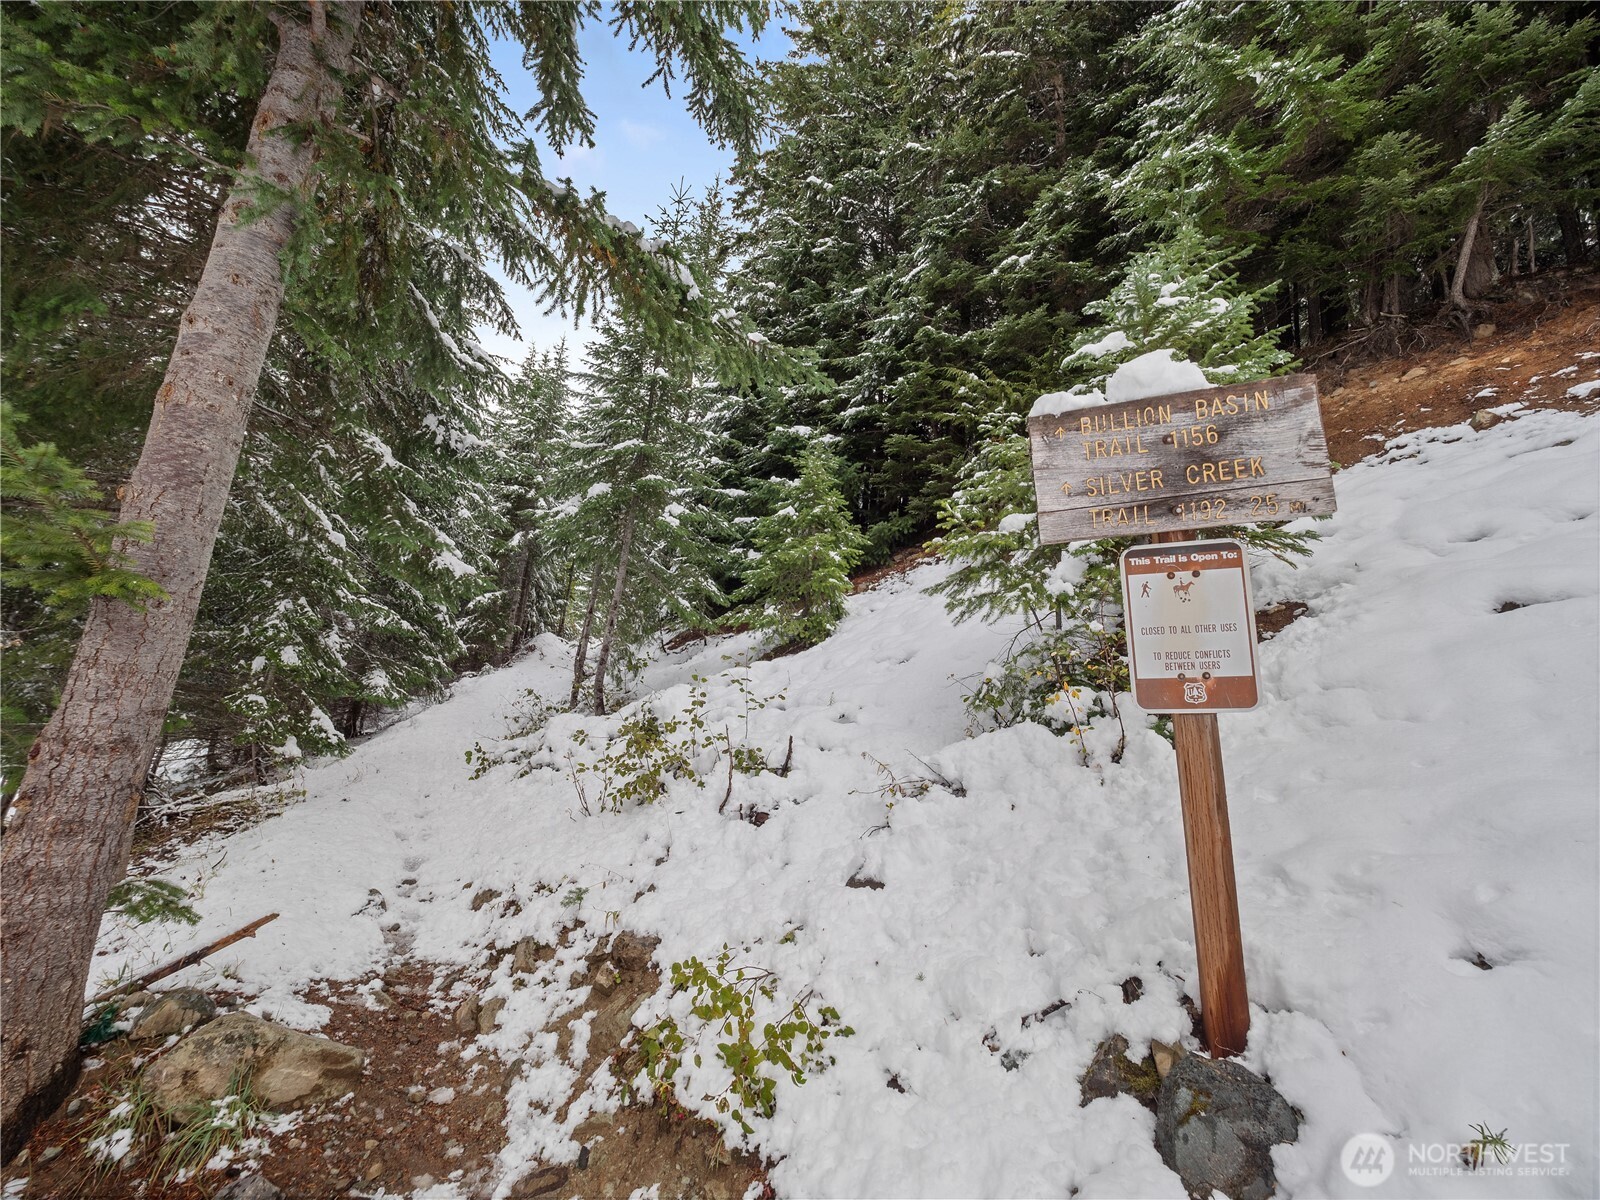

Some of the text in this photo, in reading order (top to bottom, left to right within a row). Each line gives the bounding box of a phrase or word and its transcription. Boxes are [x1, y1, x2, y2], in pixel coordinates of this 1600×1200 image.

[1080, 390, 1270, 436] BULLION BASIN
[1082, 424, 1219, 460] TRAIL 1156
[1086, 456, 1266, 498] SILVER CREEK
[1088, 505, 1156, 529] TRAIL
[1178, 499, 1228, 523] 1192
[1129, 551, 1238, 566] This Trail is Open To:
[1141, 623, 1238, 636] CLOSED TO ALL OTHER USES
[1153, 650, 1231, 661] TO REDUCE CONFLICTS
[1164, 661, 1221, 671] BETWEEN USERS
